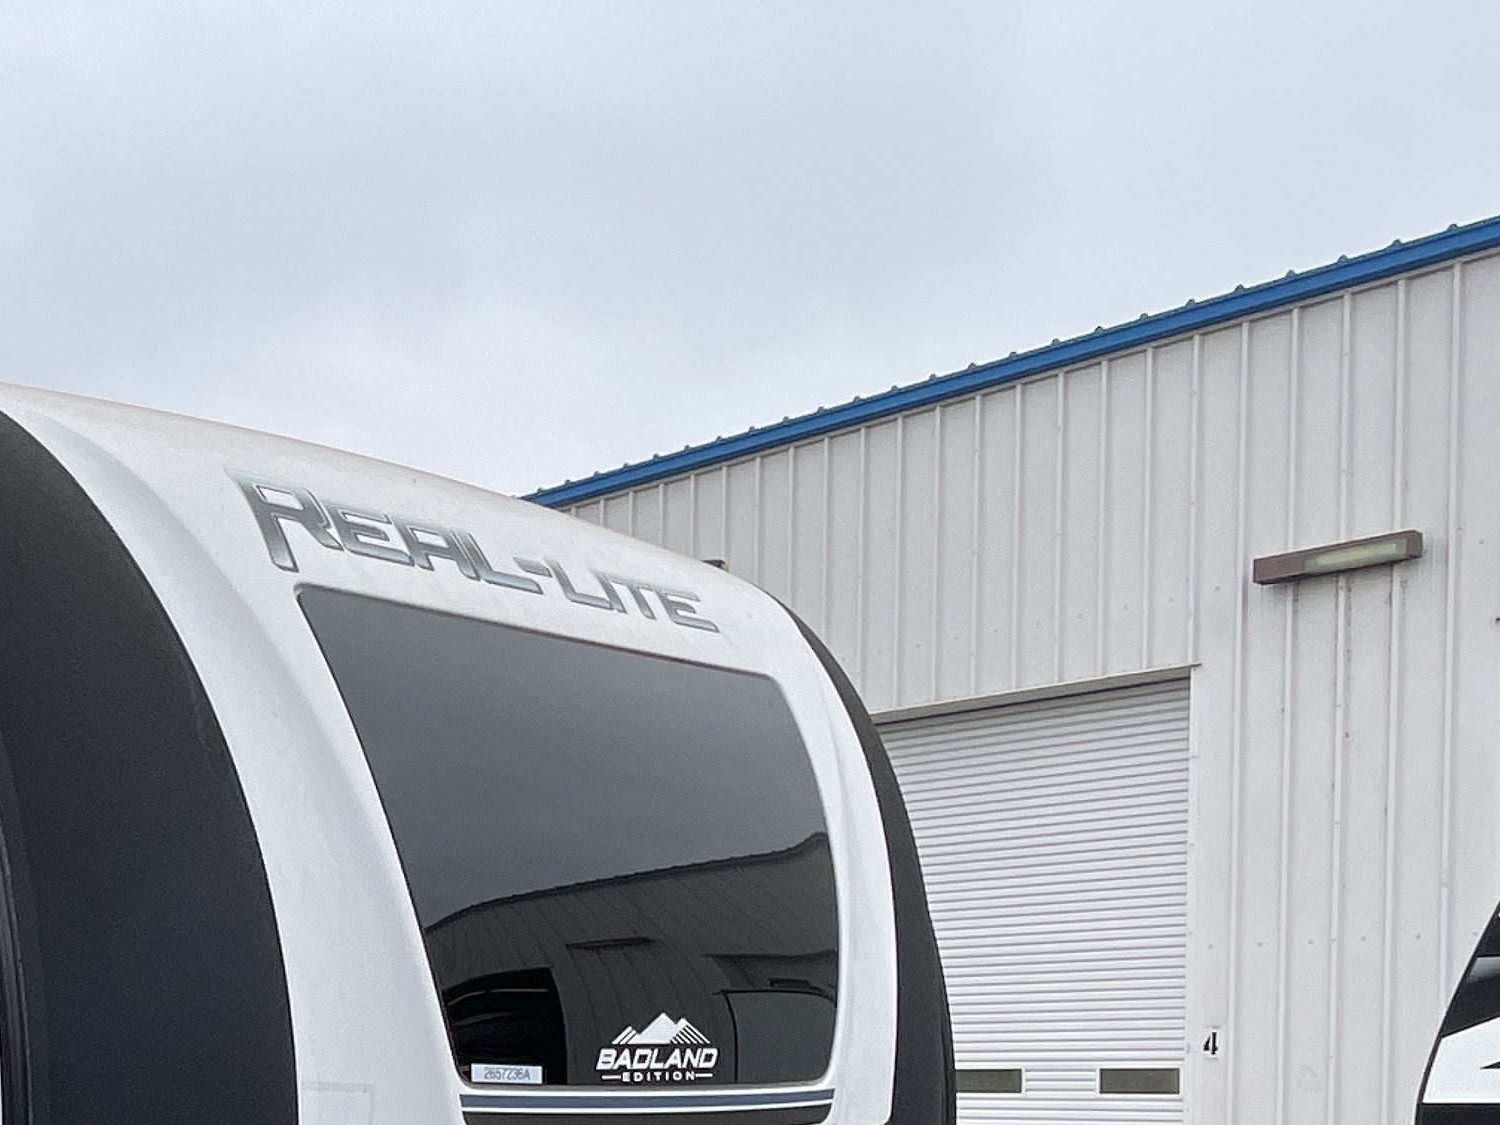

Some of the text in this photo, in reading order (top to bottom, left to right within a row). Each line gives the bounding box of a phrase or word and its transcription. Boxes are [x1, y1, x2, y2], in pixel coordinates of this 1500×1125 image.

[225, 469, 719, 633] REAL-LITE
[1203, 1031, 1218, 1054] 4
[596, 1047, 718, 1070] BADLAND
[622, 1071, 695, 1082] EDITION
